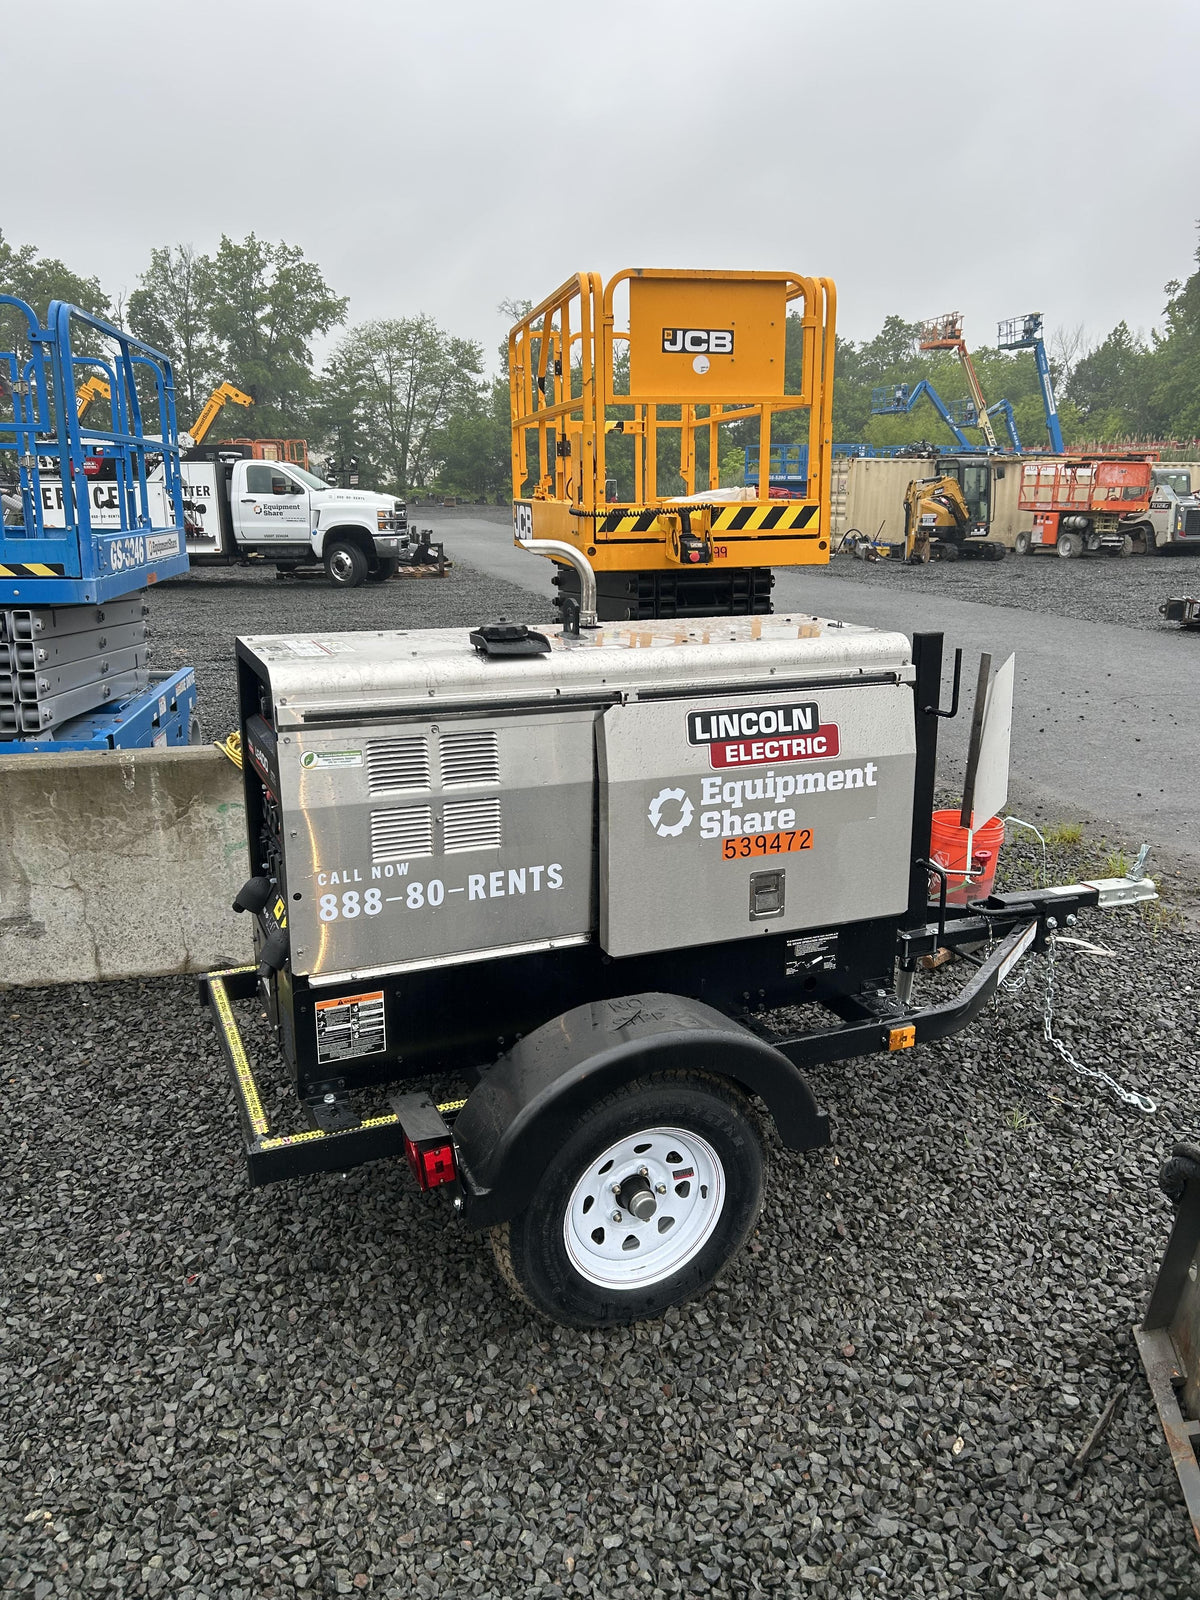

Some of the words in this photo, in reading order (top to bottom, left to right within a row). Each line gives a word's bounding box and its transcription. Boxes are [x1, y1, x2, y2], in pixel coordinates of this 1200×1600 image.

[663, 330, 732, 352] JCB
[263, 503, 300, 511] Equipment
[514, 504, 533, 540] JCB
[110, 536, 144, 571] GS-3246
[695, 707, 812, 740] LINCOLN
[725, 736, 827, 763] ELECTRIC
[701, 762, 878, 809] Equipment
[700, 808, 796, 839] Share
[724, 829, 811, 859] 539472
[318, 868, 362, 886] CALL
[371, 862, 410, 878] NOW
[319, 863, 564, 922] 888-80-RENTS
